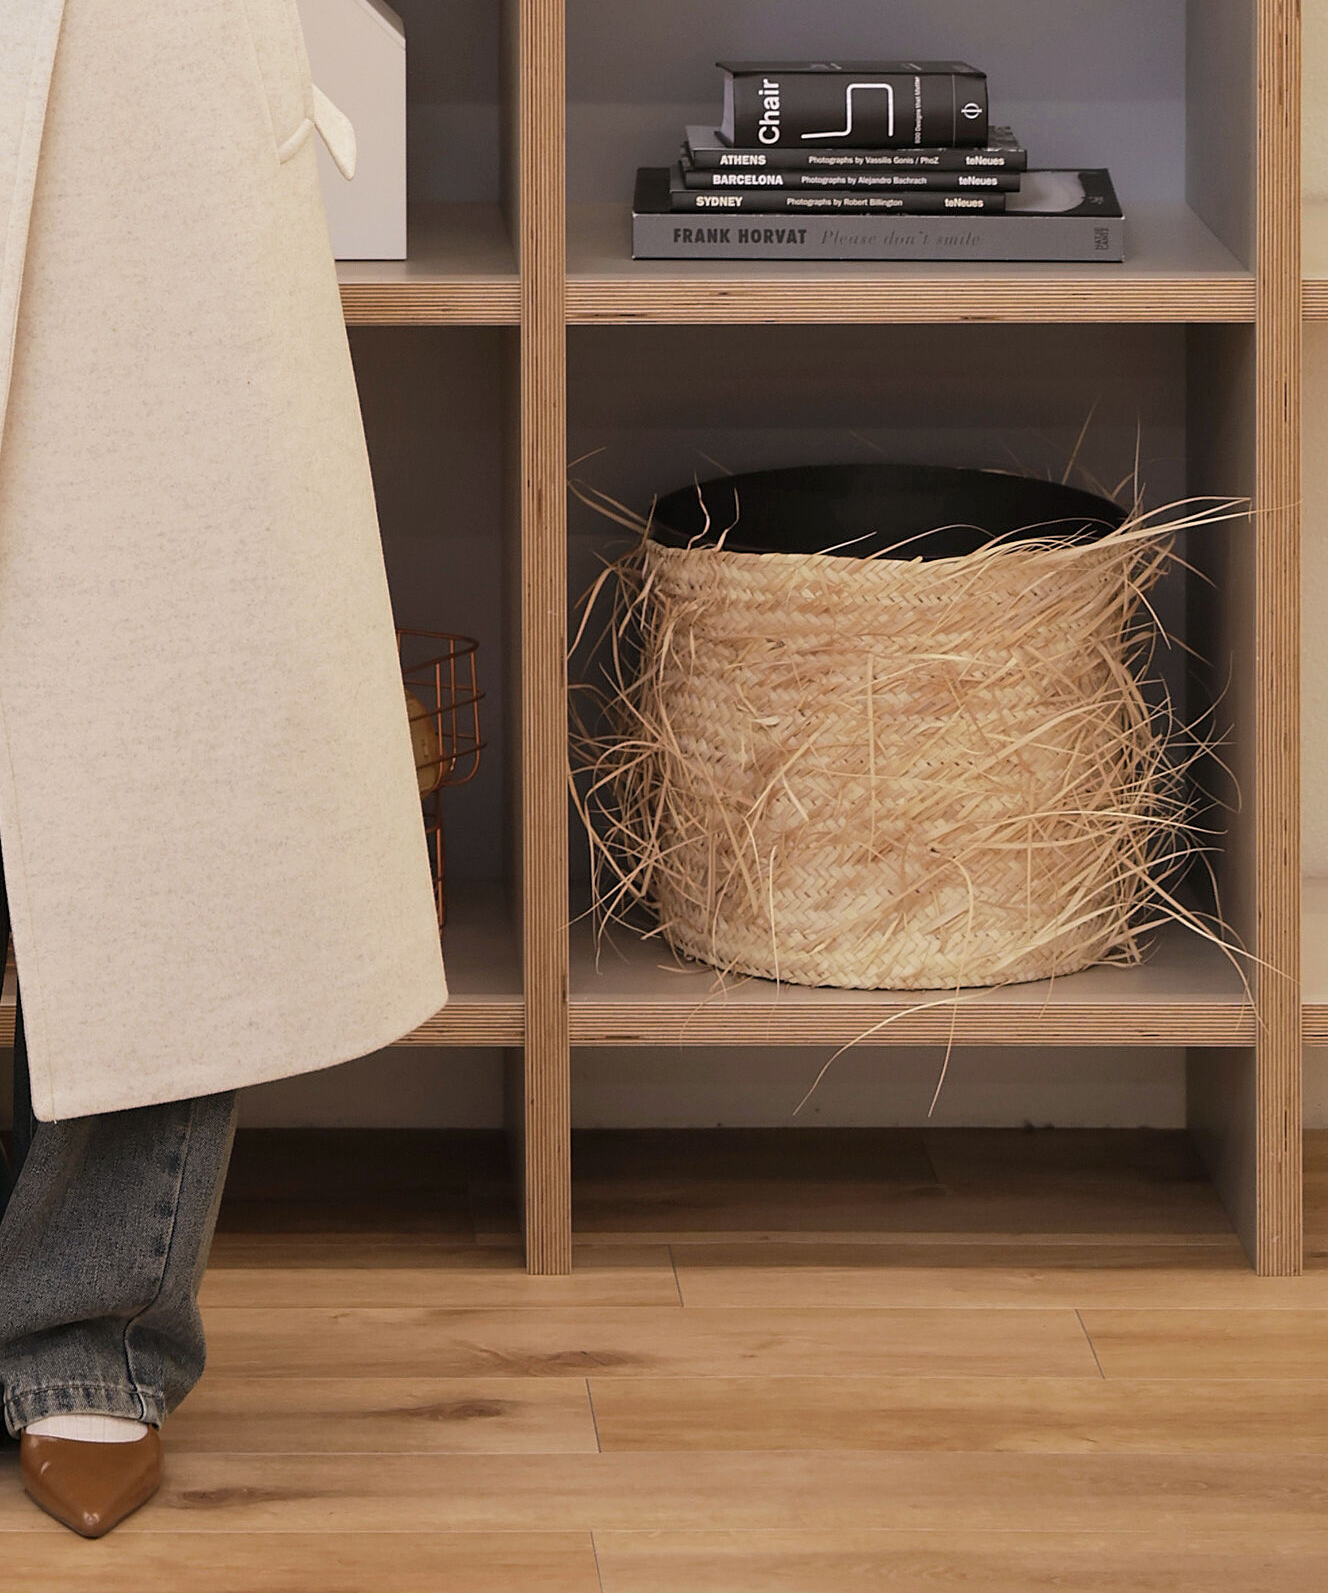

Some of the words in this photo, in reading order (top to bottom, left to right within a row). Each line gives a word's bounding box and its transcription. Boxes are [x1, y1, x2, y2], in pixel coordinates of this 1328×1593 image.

[758, 78, 780, 145] Chair
[720, 155, 767, 166] ATHENS
[808, 156, 854, 166] Photographs
[854, 156, 864, 166] by
[965, 156, 1005, 166] teNeues
[712, 174, 784, 185] BARCELONA
[801, 176, 846, 185] Photographs
[847, 176, 856, 185] by
[857, 176, 892, 185] Alejandro
[893, 176, 928, 185] Bachrach
[958, 176, 998, 186] teNeues
[695, 195, 743, 207] SYDNEY
[787, 198, 832, 207] Photographs
[833, 198, 842, 207] by
[843, 198, 868, 206] Robert
[869, 198, 903, 208] Billington
[944, 197, 984, 208] teNeues
[673, 228, 731, 244] FRANK
[738, 228, 807, 244] HORVAT
[822, 230, 876, 246] Please
[936, 231, 981, 246] smile
